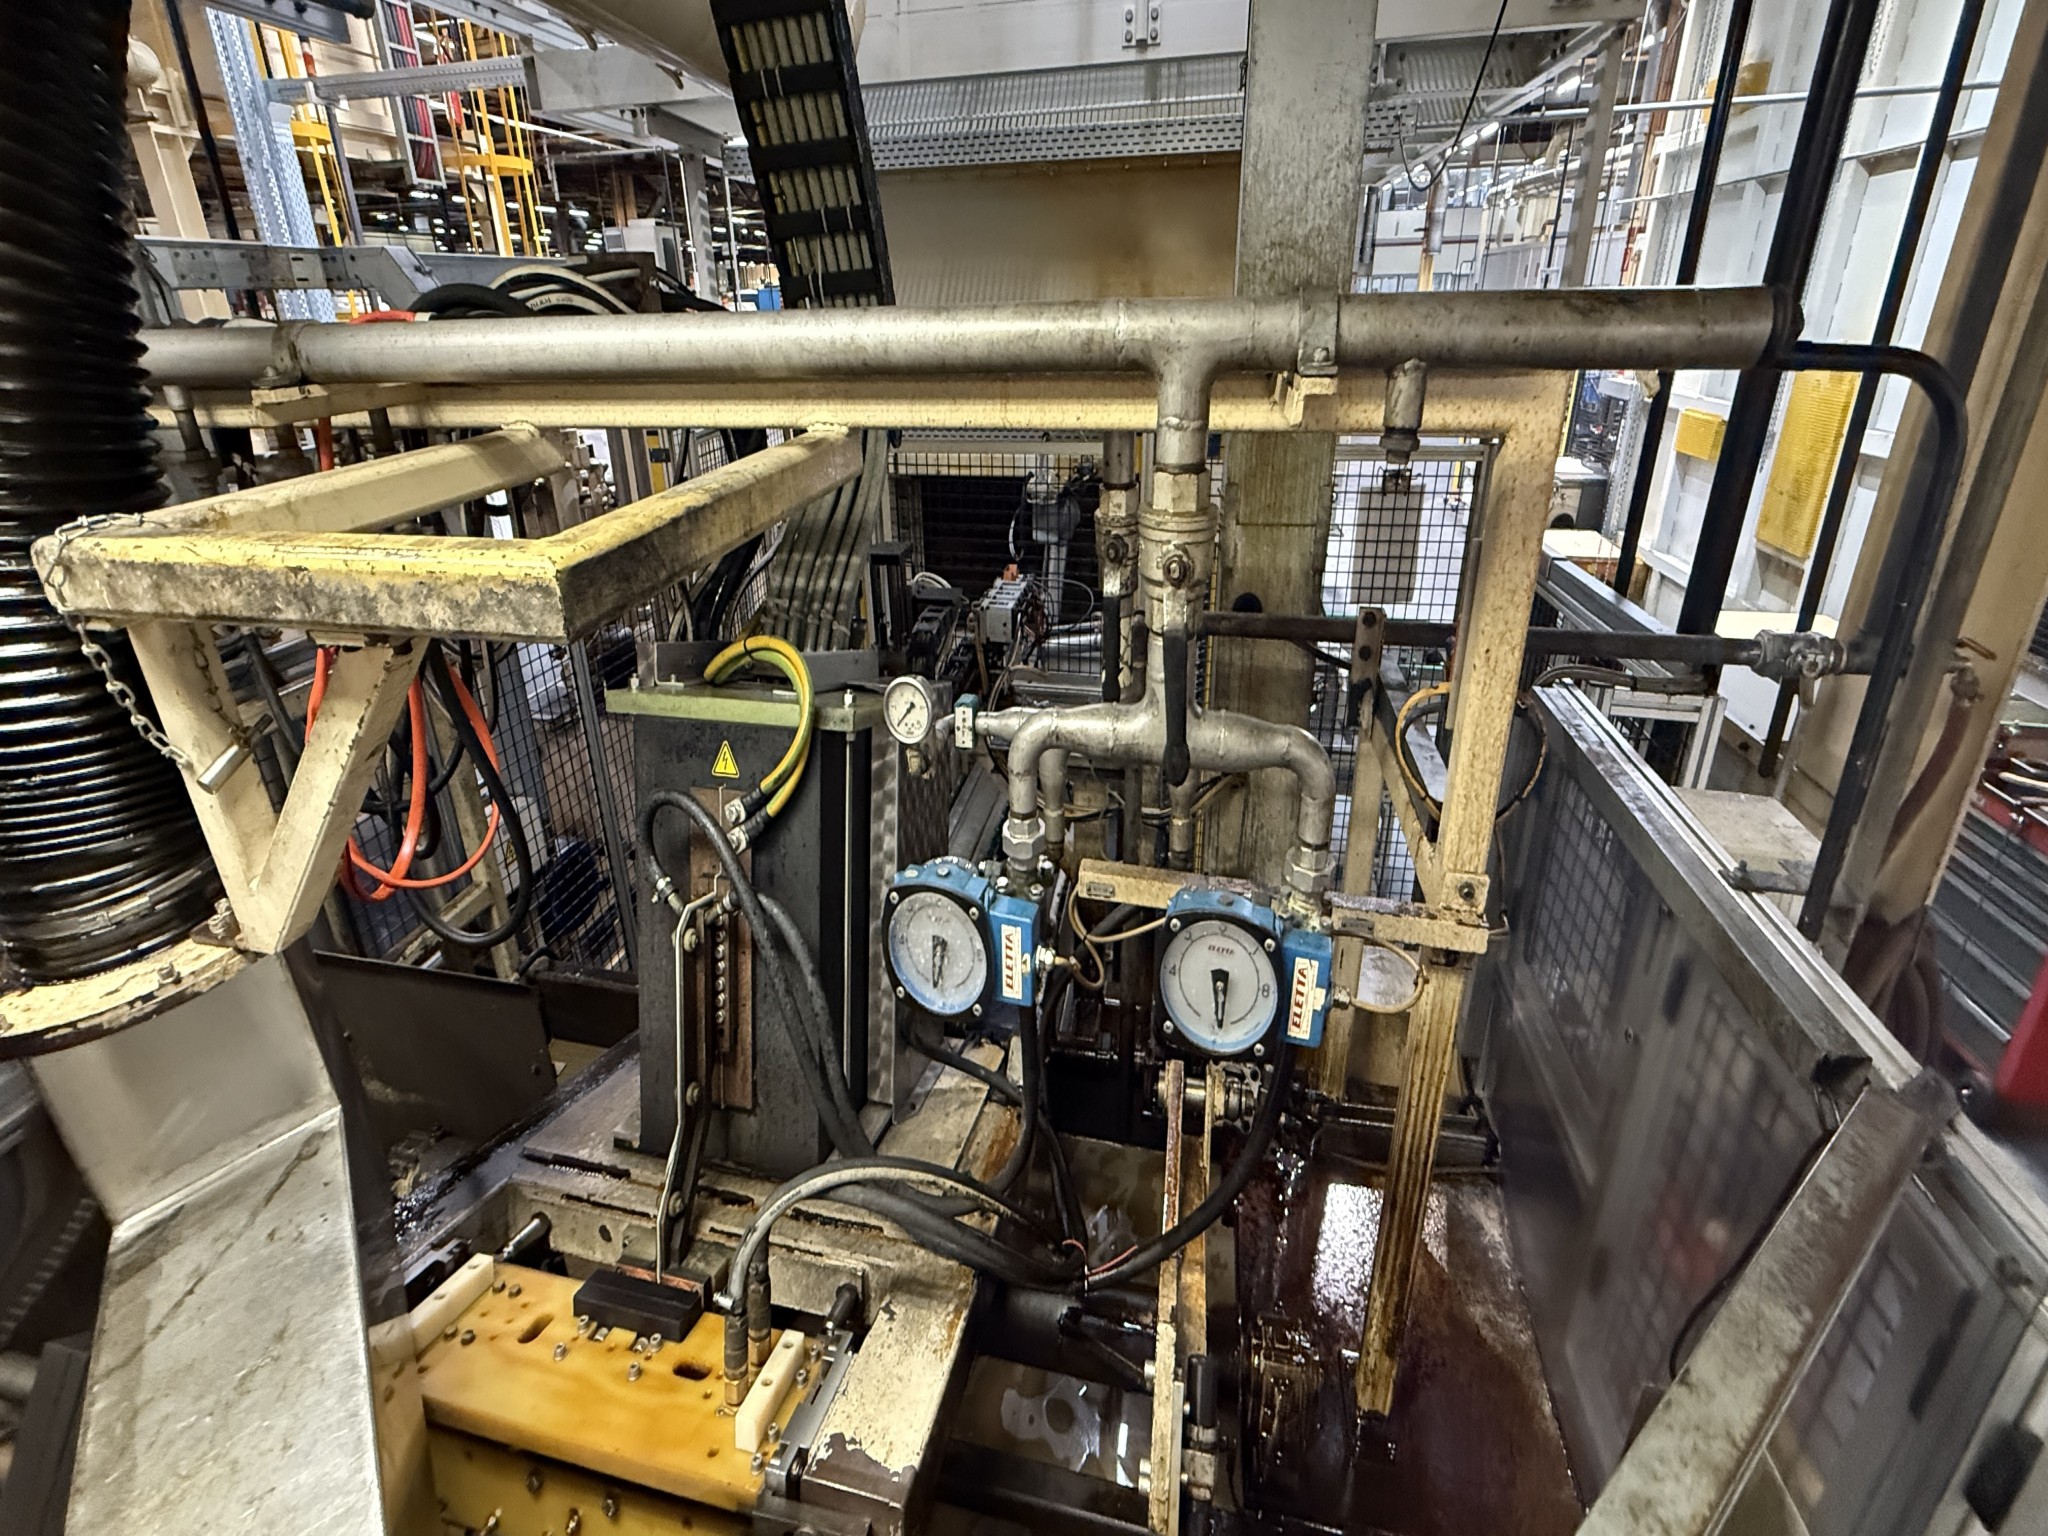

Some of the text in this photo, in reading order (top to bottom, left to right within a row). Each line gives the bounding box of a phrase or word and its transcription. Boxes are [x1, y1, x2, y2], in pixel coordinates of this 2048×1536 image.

[1005, 933, 1014, 990] ELETTA
[1168, 963, 1177, 977] 4
[1291, 966, 1308, 1030] ELETTA
